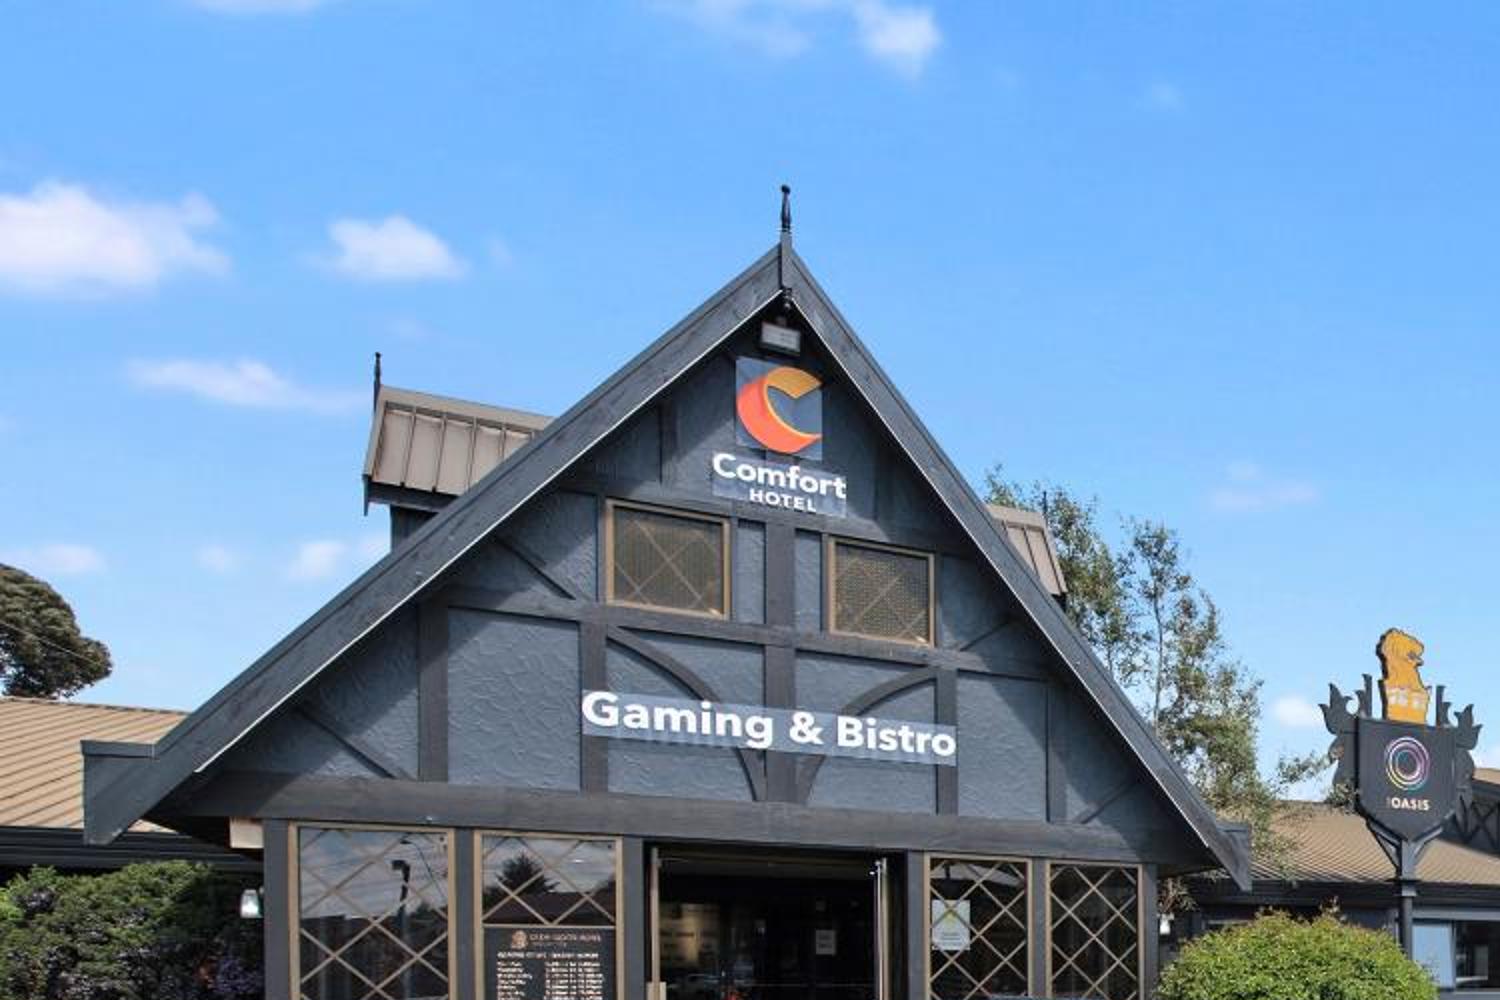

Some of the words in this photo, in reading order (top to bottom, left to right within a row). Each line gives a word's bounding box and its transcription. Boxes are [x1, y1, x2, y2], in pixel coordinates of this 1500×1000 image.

[712, 453, 847, 500] Comfort
[749, 488, 817, 513] HOTEL
[581, 691, 774, 749] Gaming
[789, 711, 824, 746] &
[837, 716, 957, 757] Bistro
[1391, 797, 1430, 811] OASIS
